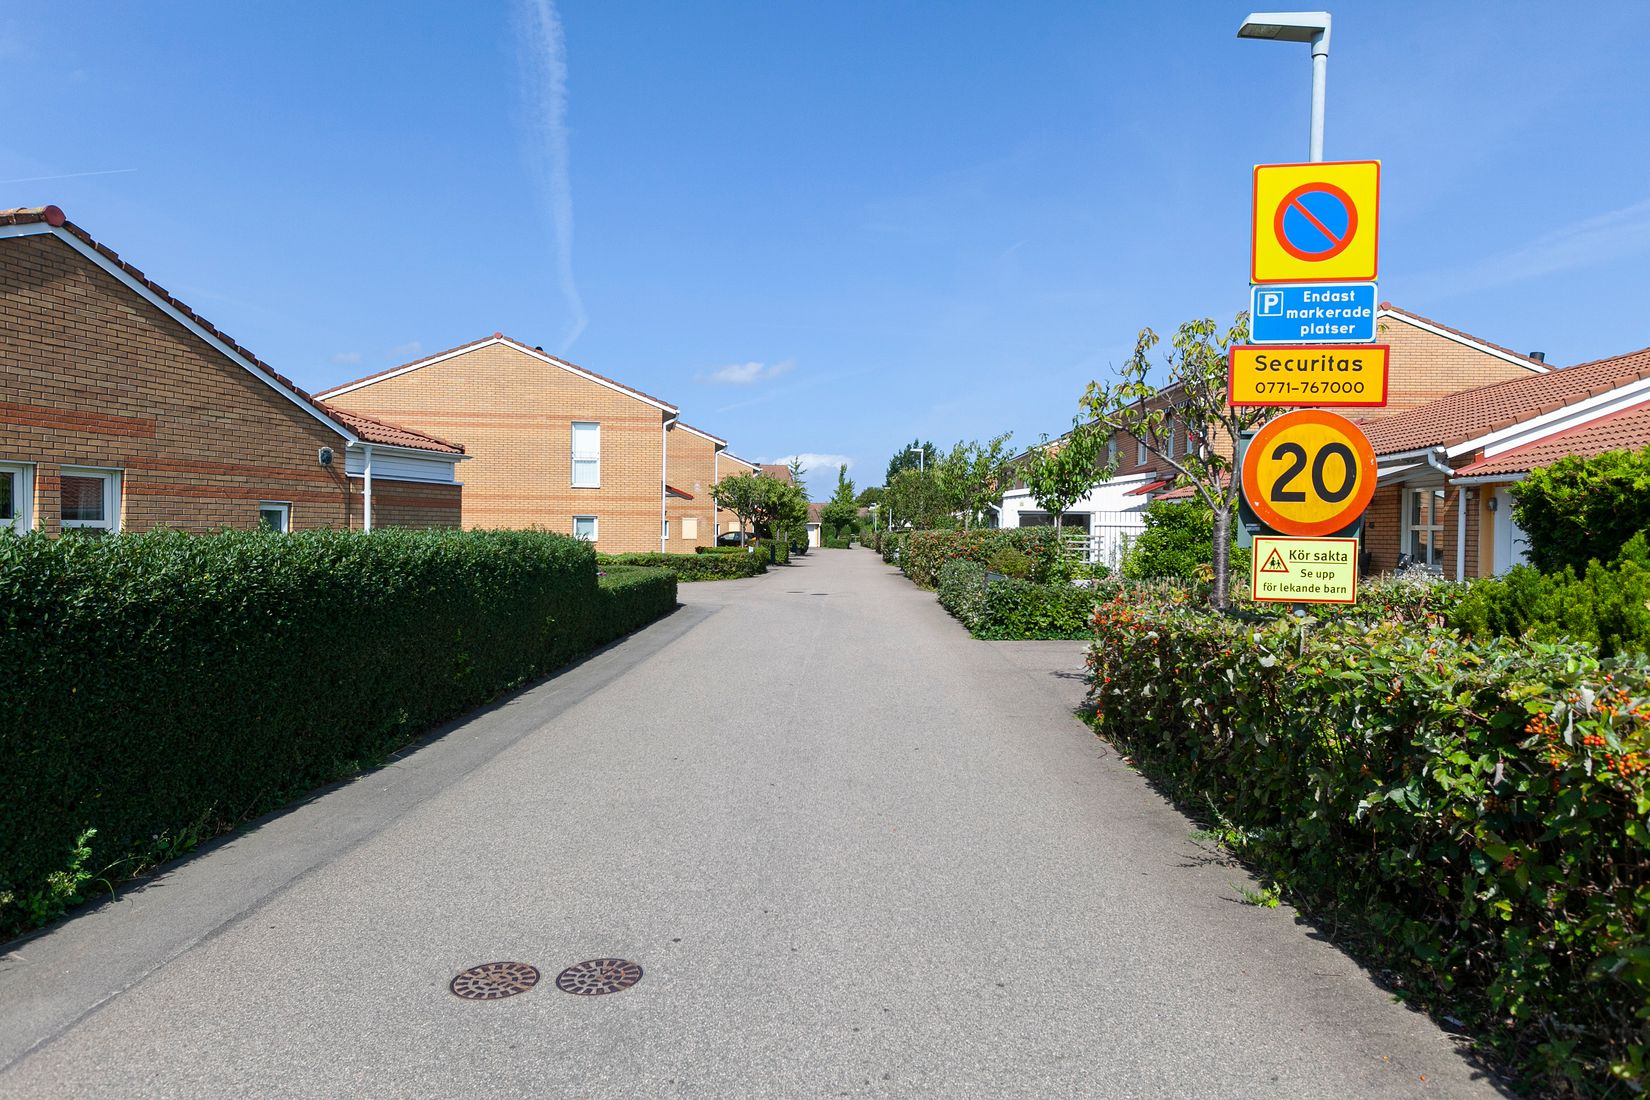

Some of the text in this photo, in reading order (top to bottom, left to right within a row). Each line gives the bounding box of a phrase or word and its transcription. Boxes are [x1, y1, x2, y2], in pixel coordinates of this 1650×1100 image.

[1303, 290, 1356, 303] Endast
[1264, 294, 1279, 313] P
[1286, 306, 1371, 319] markerade
[1300, 323, 1356, 337] platser
[1255, 355, 1363, 372] Securitas
[1255, 382, 1364, 394] 0771-767000
[1270, 442, 1357, 503] 20
[1289, 549, 1348, 562] Kör sakta
[1300, 569, 1335, 580] Se upp
[1263, 583, 1347, 594] för lekande barn
